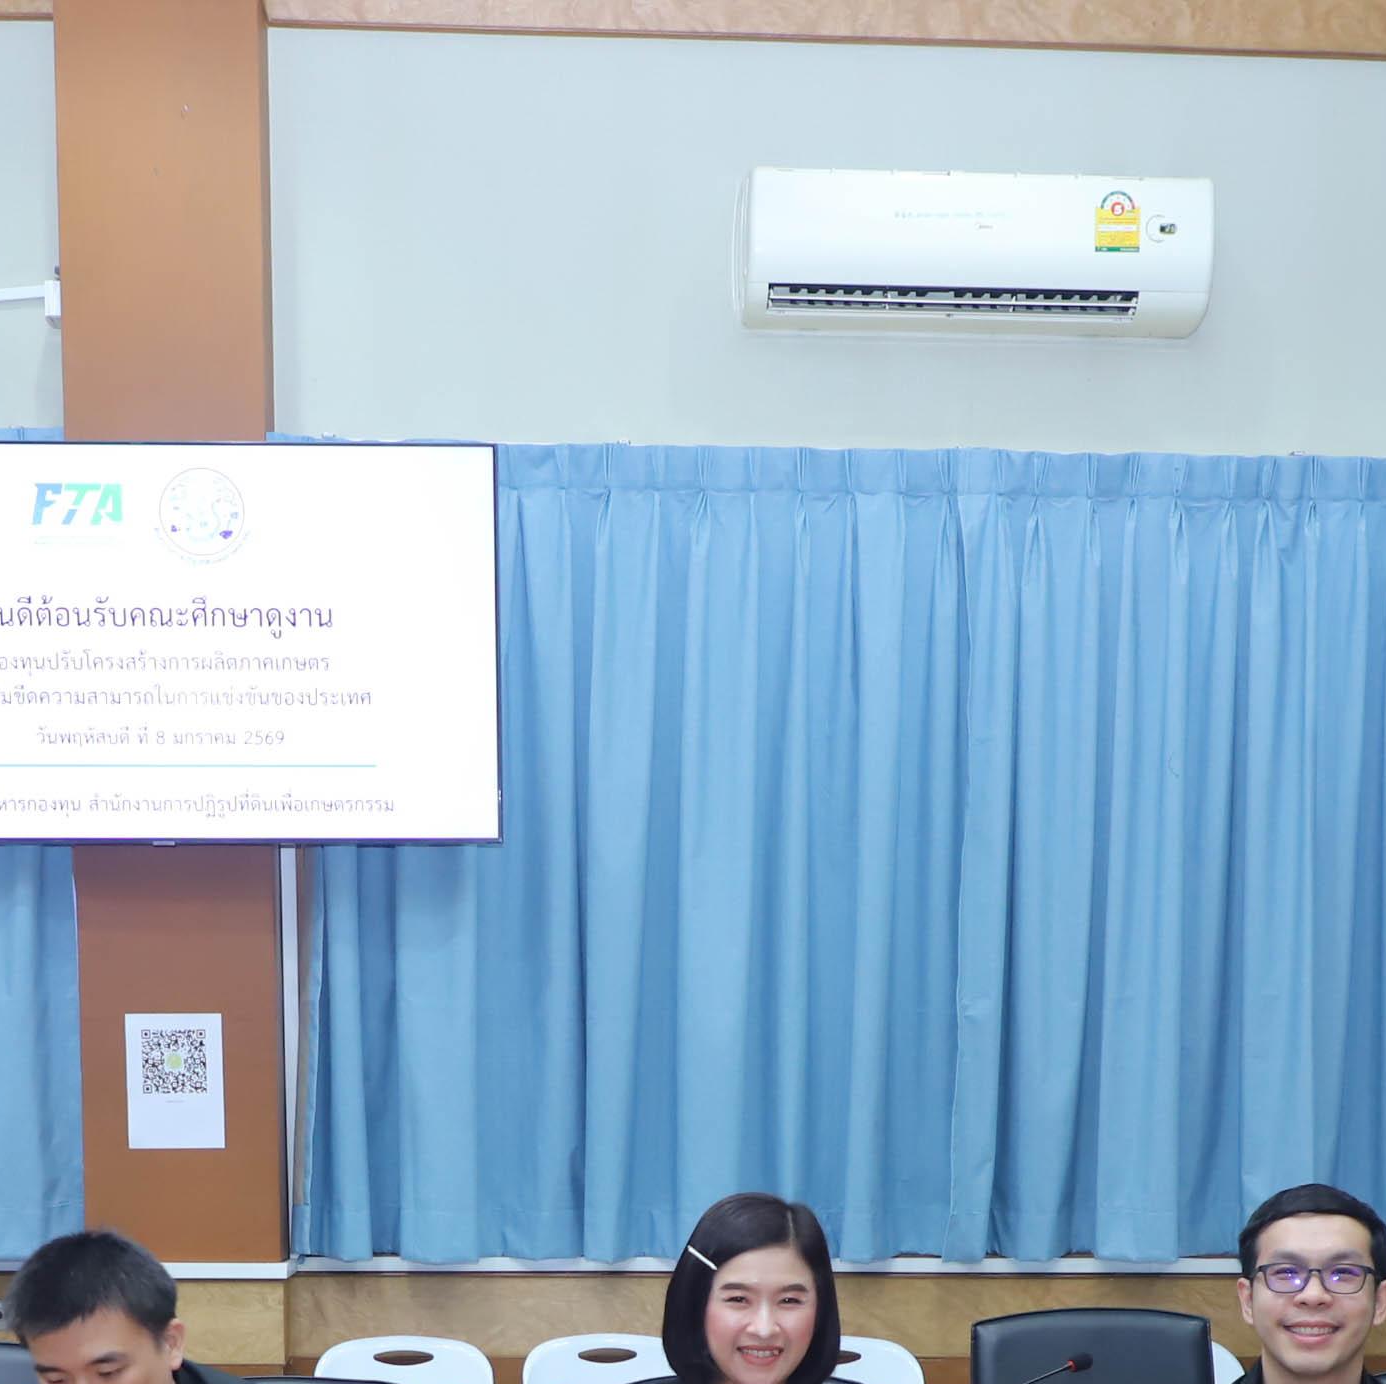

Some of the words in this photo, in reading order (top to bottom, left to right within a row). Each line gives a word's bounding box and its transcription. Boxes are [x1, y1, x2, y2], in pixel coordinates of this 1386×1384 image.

[32, 482, 123, 526] FTA
[37, 726, 129, 747] วันพฤหัสบดี
[136, 722, 149, 745] ที่
[156, 729, 166, 745] 8
[173, 732, 235, 744] มกราคม
[244, 730, 284, 745] 2569
